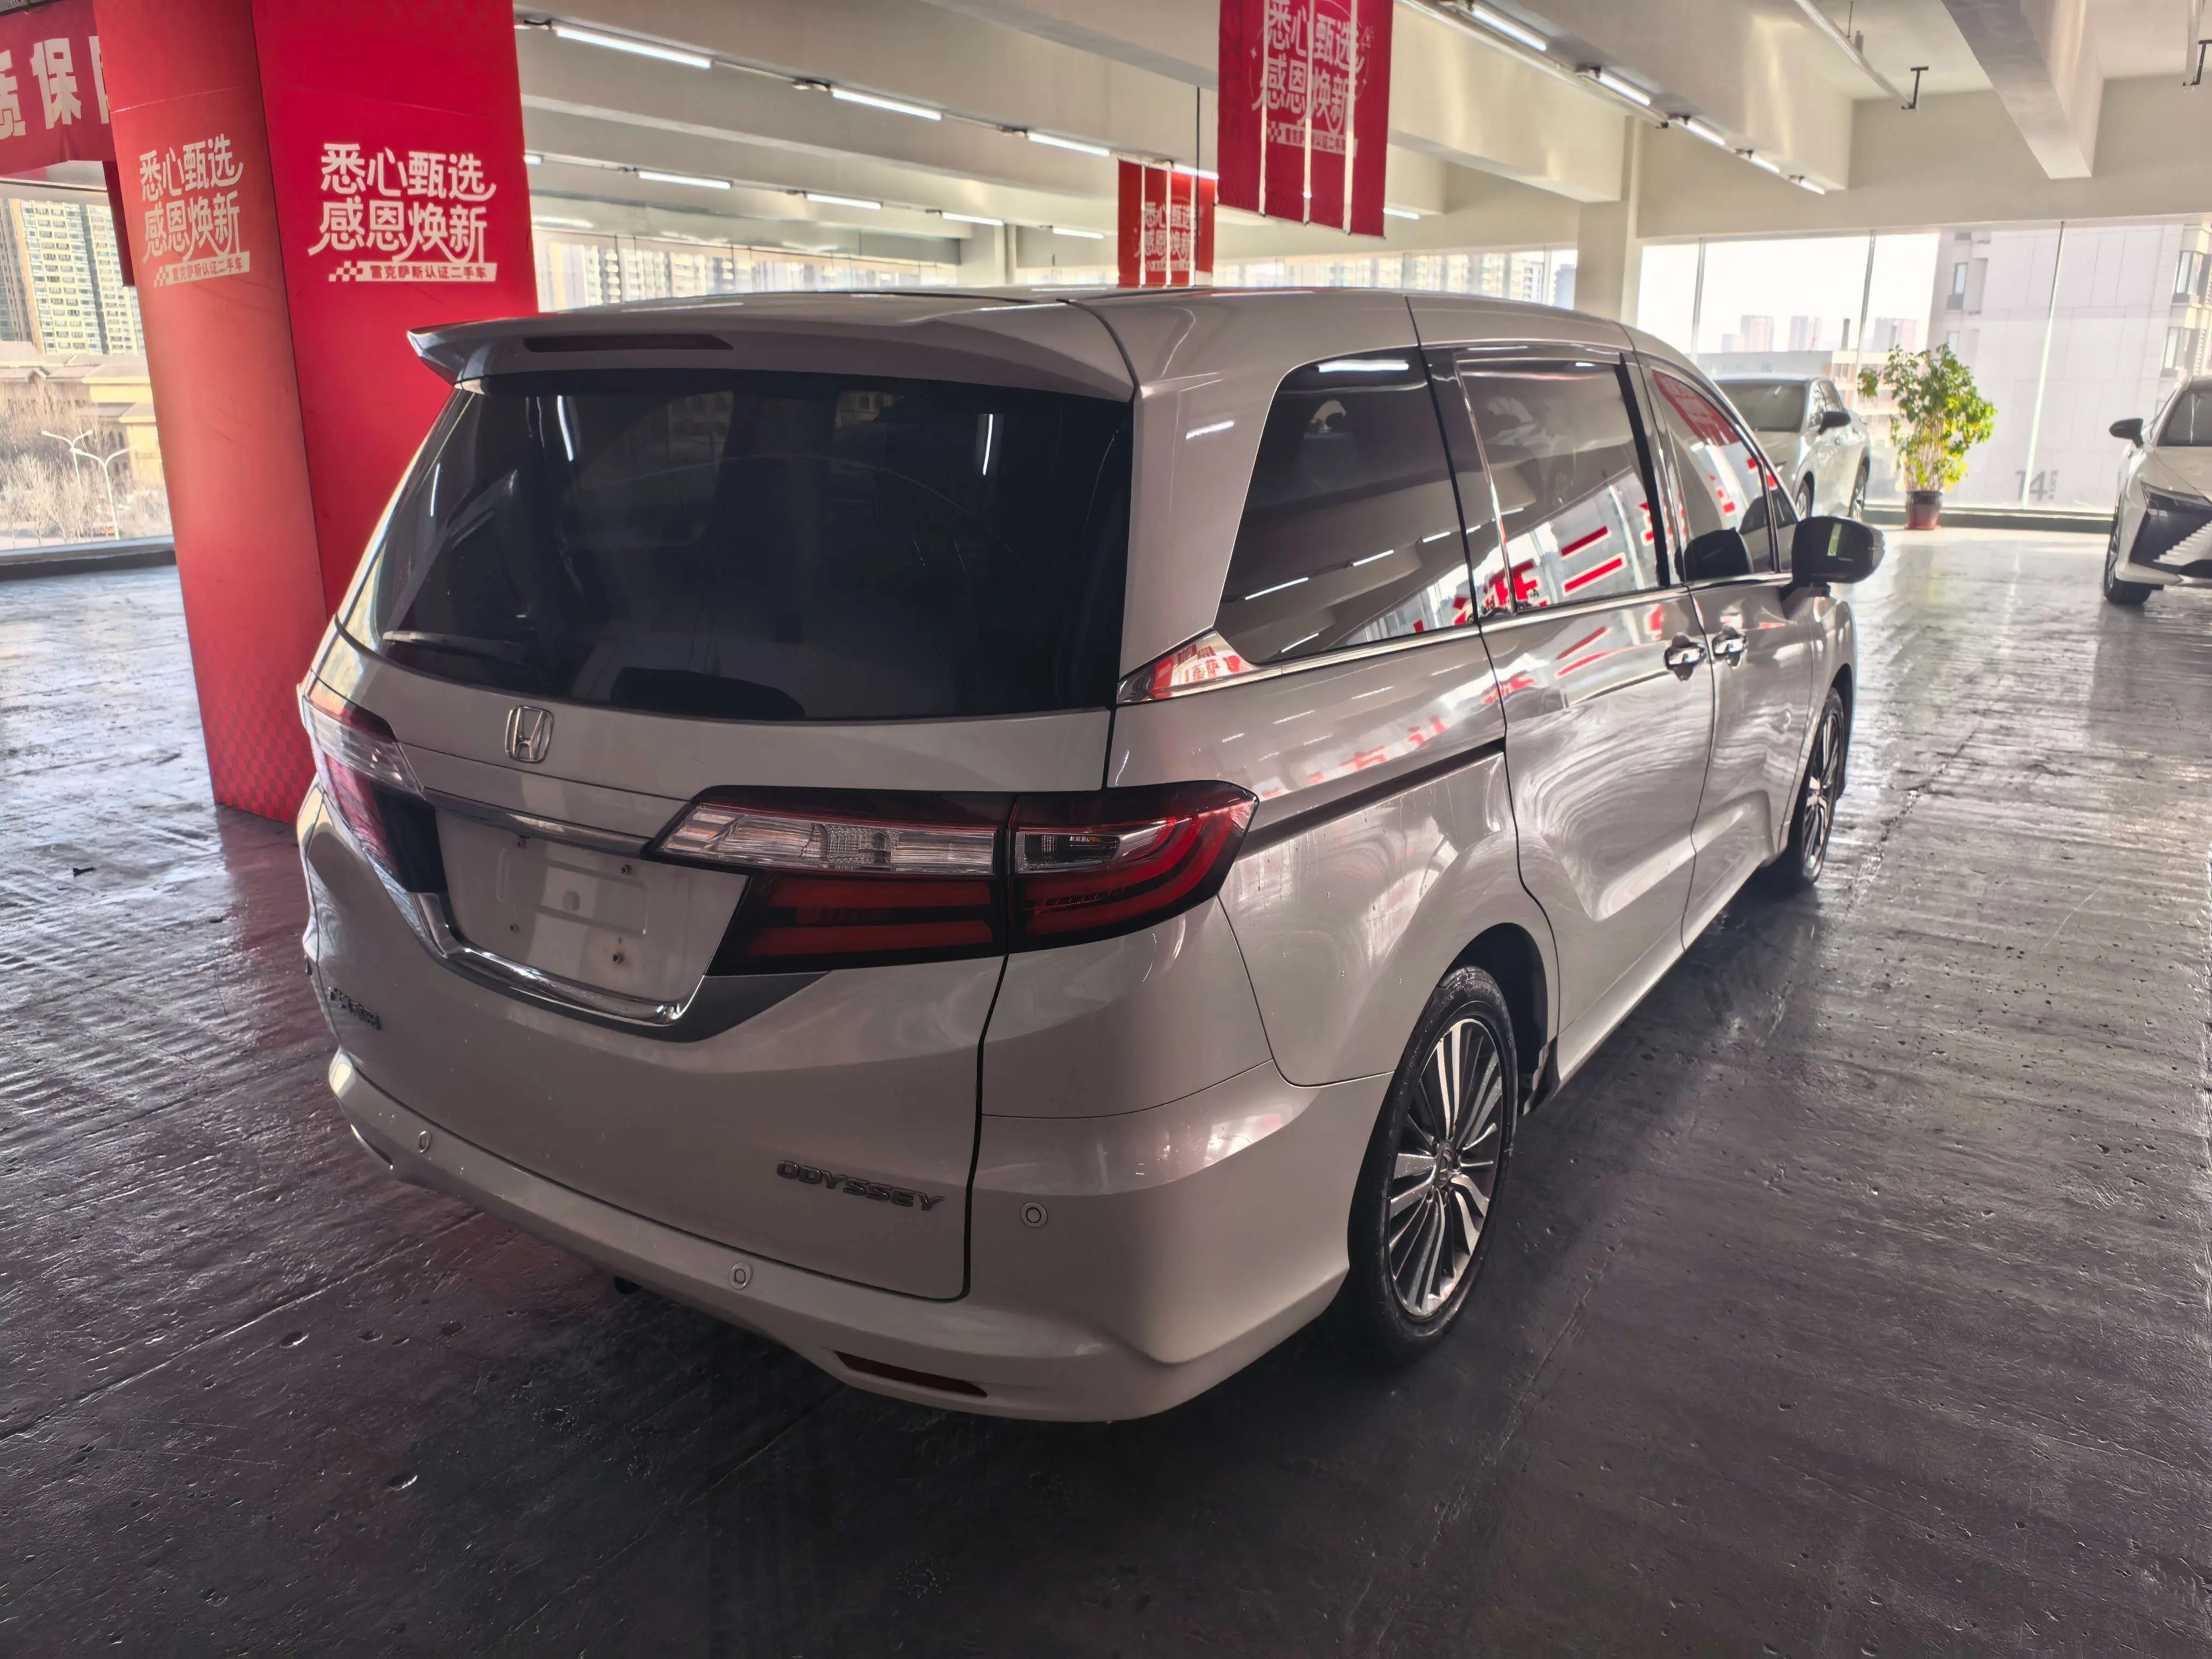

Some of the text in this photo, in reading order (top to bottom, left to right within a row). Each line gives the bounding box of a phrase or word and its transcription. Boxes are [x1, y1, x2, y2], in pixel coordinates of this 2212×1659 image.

[139, 133, 243, 202] 悉心甄选
[320, 142, 496, 201] 悉心甄选
[143, 190, 240, 264] 感恩焕新
[308, 195, 487, 265] 感恩焕新
[777, 1159, 946, 1211] ODYSSEY
